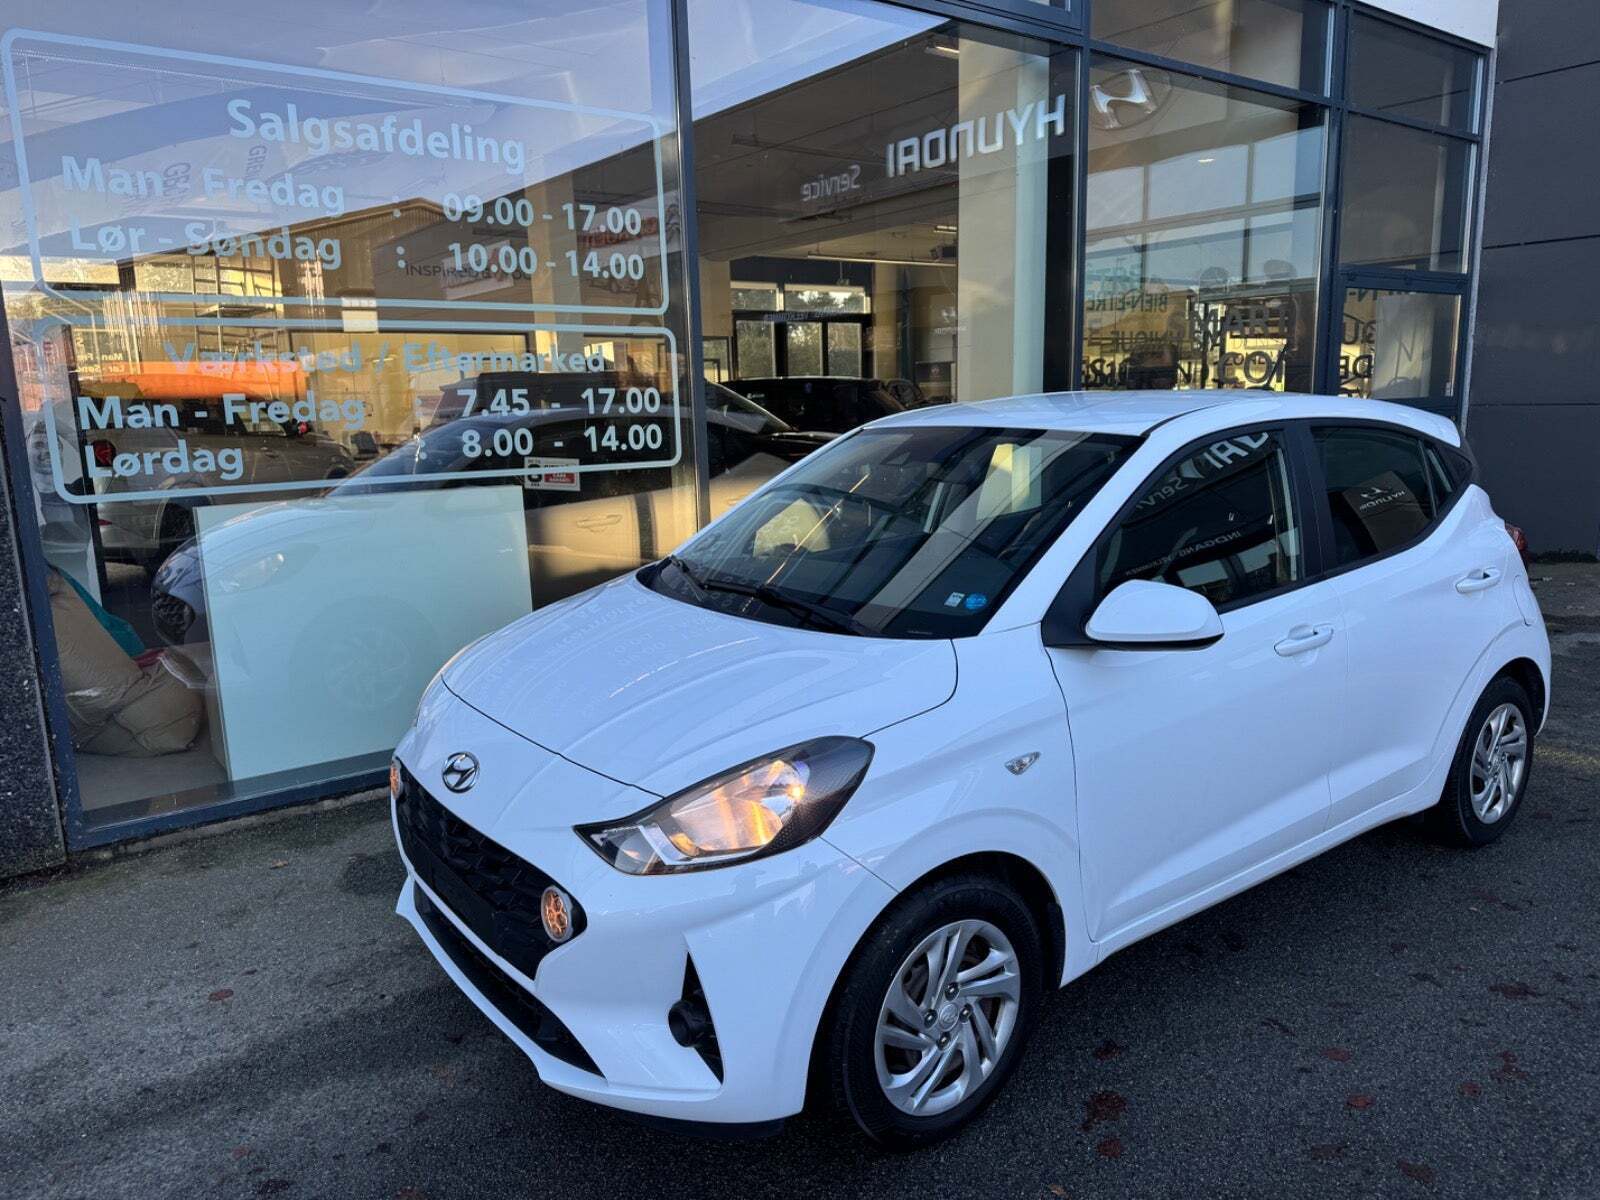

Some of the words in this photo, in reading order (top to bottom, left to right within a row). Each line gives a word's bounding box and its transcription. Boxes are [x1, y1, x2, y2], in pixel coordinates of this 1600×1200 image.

[226, 98, 525, 175] Salgsafdeling
[61, 155, 166, 197] Man
[202, 166, 345, 213] Fredag
[443, 193, 535, 227] 09.00
[562, 202, 642, 236] 17.00
[70, 214, 146, 254] Lør
[185, 221, 342, 270] Søndag
[448, 242, 538, 275] 10.00
[565, 250, 645, 281] 14.00
[162, 339, 362, 374] Værksted
[403, 340, 605, 374] Eftermarked
[78, 395, 180, 430] Man
[223, 390, 366, 429] Fredag
[457, 388, 531, 418] 7.45
[581, 387, 661, 415] 17.00
[85, 439, 244, 481] Lørdag
[462, 427, 534, 458] 8.00
[584, 423, 663, 453] 14.00
